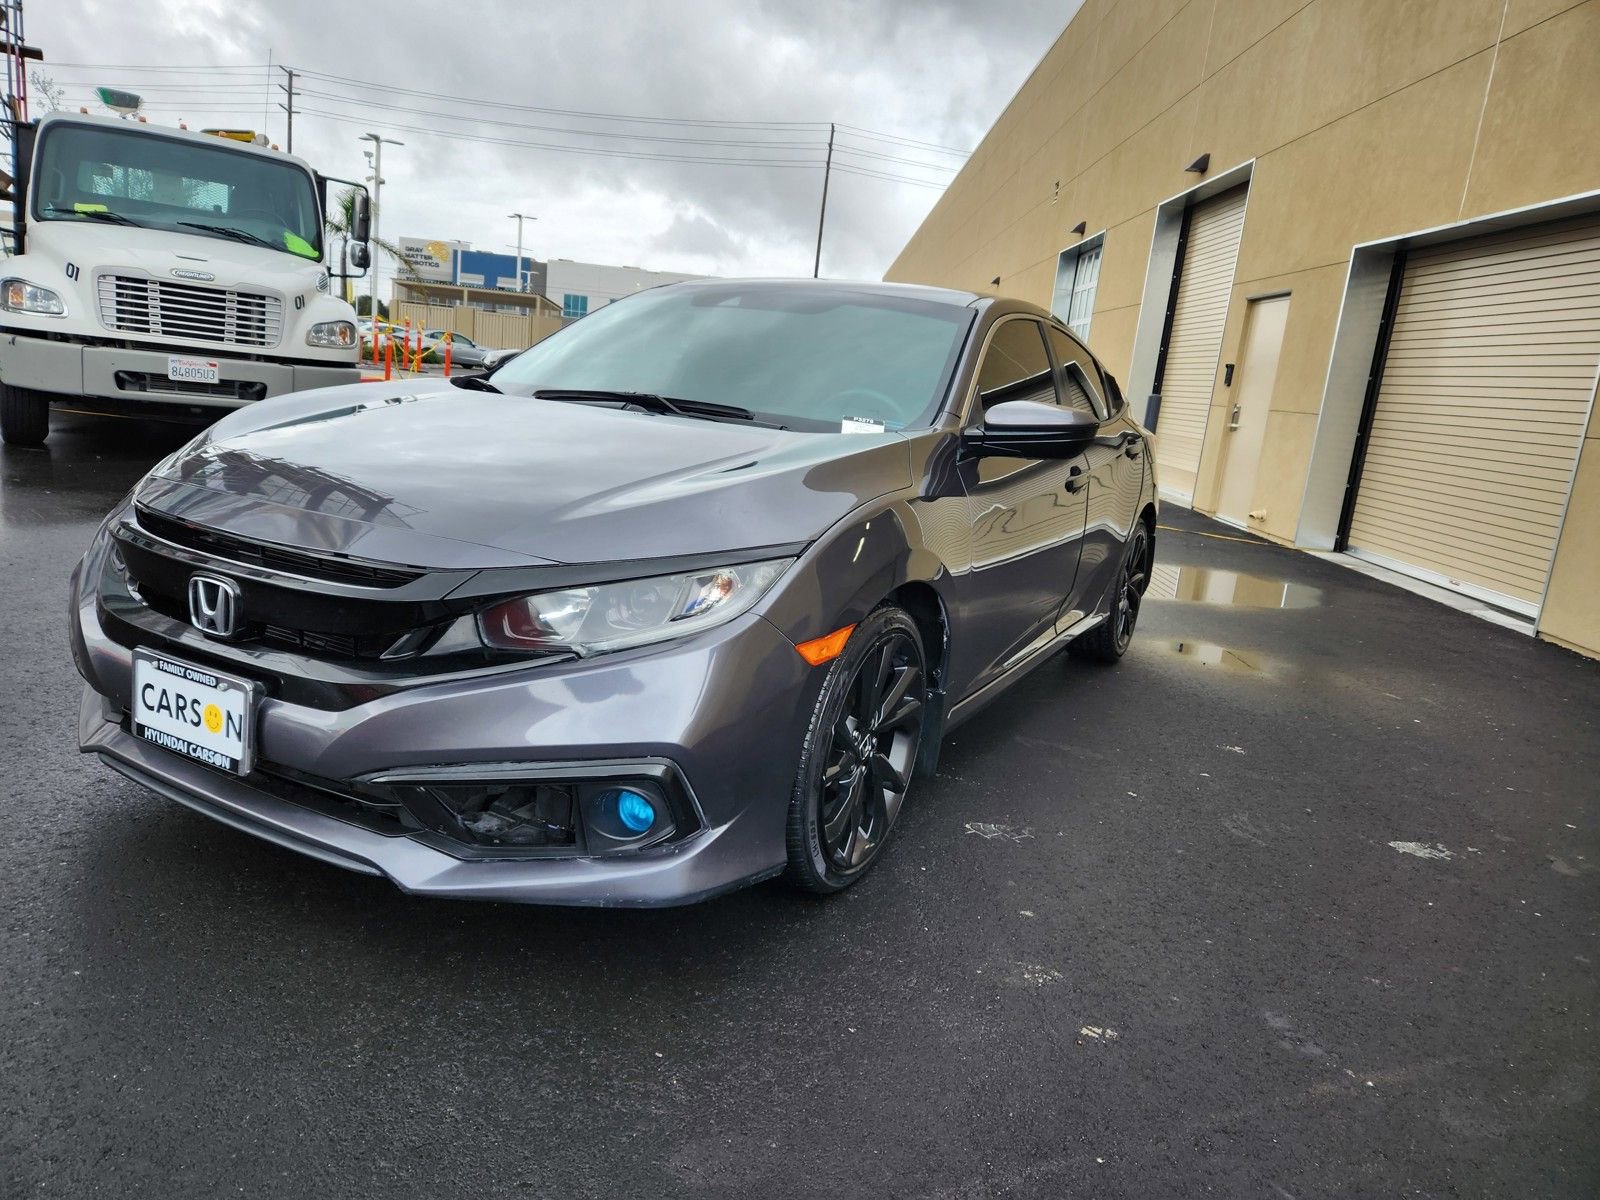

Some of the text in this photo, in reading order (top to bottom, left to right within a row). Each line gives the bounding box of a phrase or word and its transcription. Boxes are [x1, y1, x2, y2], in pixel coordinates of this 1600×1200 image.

[66, 261, 80, 281] 01
[405, 258, 440, 268] OBOTICS
[295, 294, 304, 310] 01
[171, 366, 215, 380] 84805U3
[160, 661, 217, 686] FAMILY OWNED
[144, 727, 231, 769] HYUNDAI CARSON
